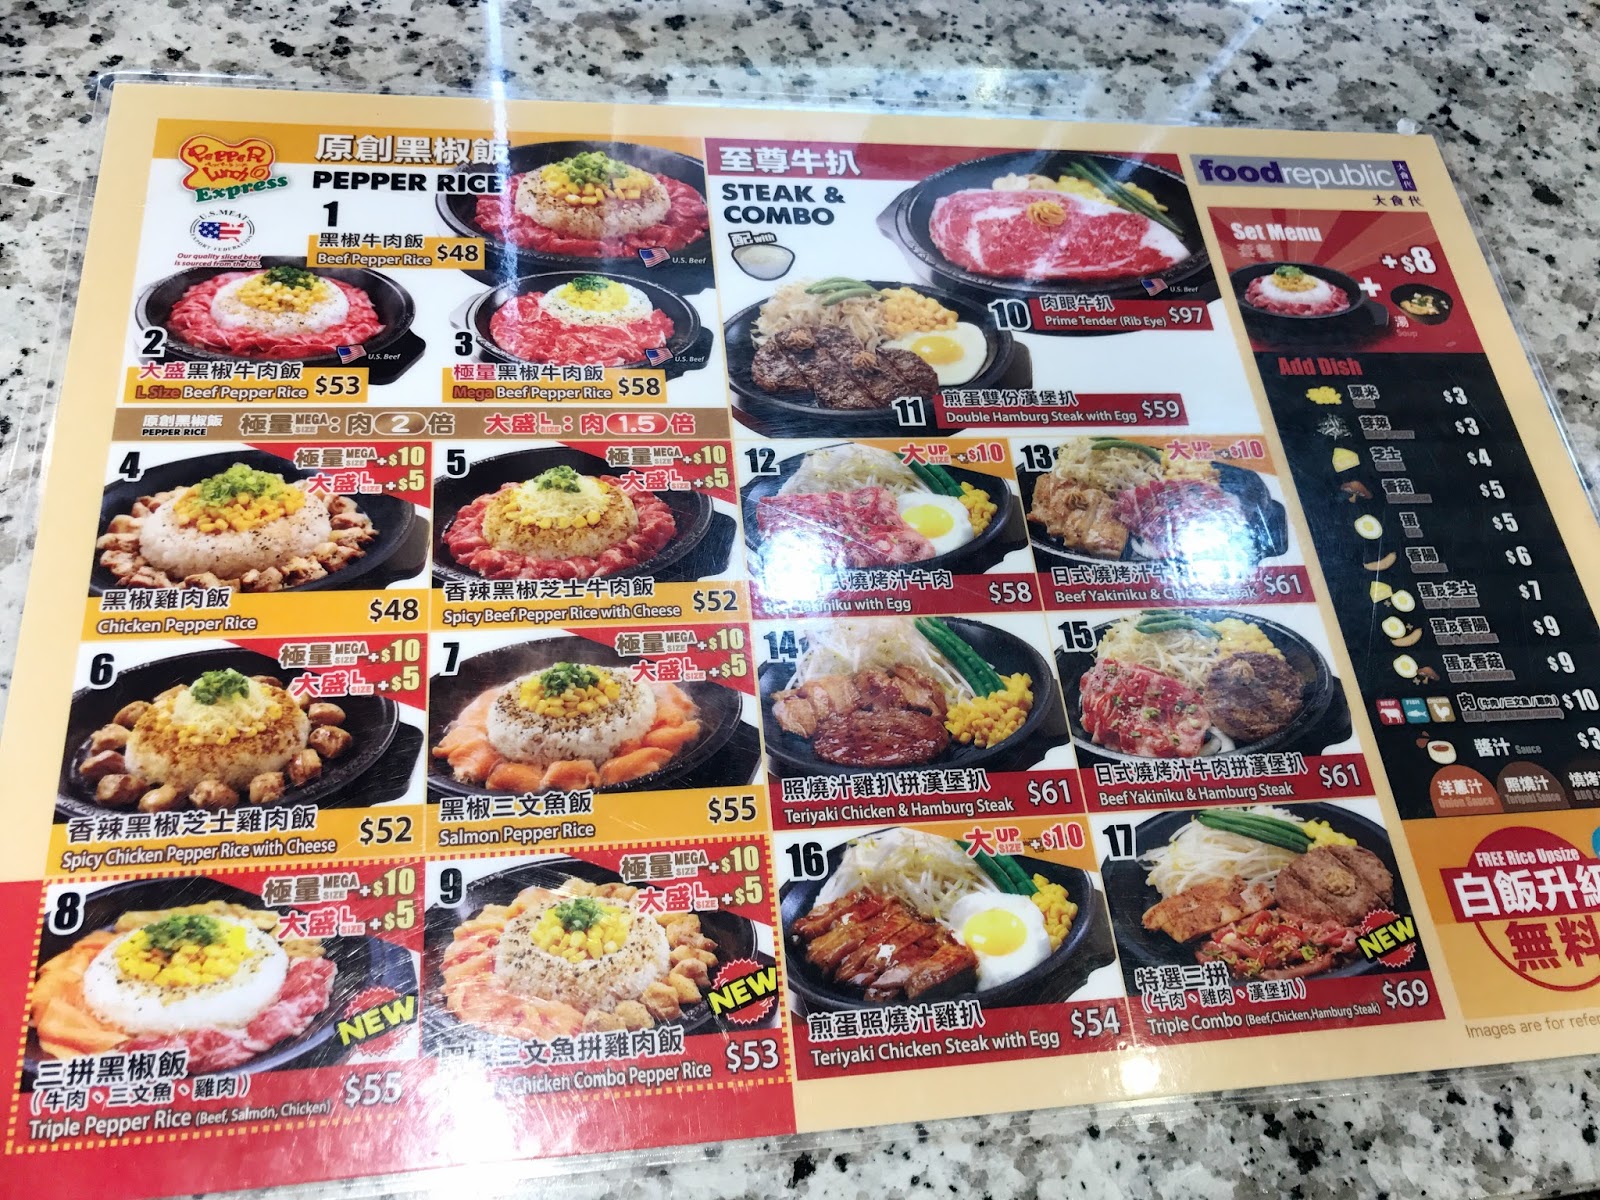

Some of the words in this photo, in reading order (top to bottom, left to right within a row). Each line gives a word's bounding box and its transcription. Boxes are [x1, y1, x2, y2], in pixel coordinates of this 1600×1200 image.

[719, 146, 862, 177] 至尊牛扒
[196, 176, 288, 202] Express
[312, 171, 427, 191] PEPPER
[437, 176, 504, 194] RICE
[721, 182, 816, 203] STEAK
[824, 186, 846, 204] &
[723, 205, 835, 225] COMBO
[318, 232, 425, 249] 黑椒牛肉飯
[1230, 222, 1265, 241] Set
[1267, 223, 1323, 242] Menu
[192, 253, 219, 261] quality
[316, 252, 351, 266] Beef
[351, 253, 400, 268] Pepper
[403, 255, 432, 266] Rice
[437, 244, 480, 262] $48
[688, 256, 706, 265] Beef
[1045, 315, 1077, 327] Prime
[1078, 316, 1119, 327] Tender
[1119, 315, 1140, 329] (Rib
[1140, 315, 1167, 329] Eye)
[1168, 307, 1204, 325] $97
[382, 353, 401, 361] Beef
[1277, 356, 1316, 376] Add
[1319, 357, 1364, 377] Dish
[139, 361, 303, 381] 大盛黑椒牛肉飯
[183, 386, 219, 399] Beef
[220, 386, 276, 402] Pepper
[277, 386, 308, 399] Rice
[315, 375, 361, 396] $53
[452, 386, 495, 401] Mega
[496, 386, 529, 399] Beef
[530, 387, 581, 403] Pepper
[582, 387, 612, 400] Rice
[617, 377, 661, 397] $58
[1443, 386, 1469, 406] $3
[946, 410, 991, 424] Double
[992, 411, 1049, 427] Hamburg
[1051, 410, 1084, 423] Steak
[1084, 409, 1112, 422] with
[1113, 411, 1138, 425] Egg
[1140, 400, 1180, 420] $59
[142, 428, 182, 437] PEPPER
[183, 428, 207, 437] RICE
[1454, 417, 1480, 436] $3
[1466, 448, 1493, 468] $4
[1479, 480, 1506, 500] $5
[1492, 512, 1519, 533] $5
[1505, 546, 1533, 566] $6
[444, 577, 654, 602] 香辣黑椒芝士牛肉飯
[988, 581, 1033, 604] $58
[1054, 590, 1087, 603] Beef
[1088, 588, 1147, 602] Yakiniku
[1149, 589, 1161, 601] &
[1263, 574, 1303, 596] $61
[1518, 580, 1542, 601] $7
[101, 587, 230, 611] 黑椒雞肉飯
[692, 589, 738, 613] $52
[855, 598, 884, 611] with
[886, 598, 912, 613] Egg
[369, 598, 419, 623] $48
[443, 609, 482, 625] Spicy
[484, 608, 517, 622] Beef
[517, 607, 568, 624] Pepper
[569, 606, 599, 620] Rice
[600, 605, 632, 619] with
[633, 603, 681, 618] Cheese
[96, 618, 162, 635] Chicken
[164, 617, 222, 635] Pepper
[223, 616, 257, 631] Rice
[1532, 615, 1561, 637] $9
[1547, 651, 1577, 674] $9
[1562, 688, 1600, 711] $10
[1319, 763, 1361, 789] $61
[1027, 779, 1073, 807] $61
[1099, 792, 1129, 807] Beef
[1129, 789, 1184, 805] Yakiniku
[1186, 789, 1197, 802] &
[1198, 785, 1258, 803] Hamburg
[1258, 782, 1295, 799] Steak
[439, 791, 593, 822] 黑椒三文魚飯
[708, 796, 756, 824] $55
[784, 807, 838, 826] Teriyaki
[840, 803, 896, 820] Chicken
[897, 803, 910, 817] &
[911, 799, 975, 819] Hamburg
[976, 797, 1015, 813] Steak
[68, 805, 317, 843] 香辣黑椒芝士雞肉飯
[359, 816, 412, 845] $52
[438, 827, 501, 847] Salmon
[502, 825, 561, 846] Pepper
[562, 823, 595, 840] Rice
[61, 851, 103, 871] Spicy
[105, 846, 165, 866] Chicken
[166, 844, 219, 865] Pepper
[220, 842, 250, 859] Rice
[252, 841, 284, 857] with
[286, 838, 336, 855] Cheese
[1474, 851, 1504, 868] FREE
[1506, 849, 1537, 866] Rice
[1536, 846, 1581, 865] Upsize
[1356, 916, 1417, 960] NEW
[707, 966, 777, 1016] NEW
[1382, 978, 1430, 1010] $69
[337, 995, 416, 1046] NEW
[1070, 1006, 1121, 1039] $54
[1146, 1016, 1190, 1037] Triple
[1191, 1011, 1243, 1031] Combo
[1353, 1002, 1382, 1018] Steak)
[1465, 1022, 1517, 1040] Images
[1520, 1020, 1543, 1032] are
[1545, 1016, 1565, 1030] for
[725, 1038, 780, 1072] $53
[811, 1045, 875, 1069] Teriyaki
[877, 1041, 942, 1060] Chicken
[944, 1036, 990, 1054] Steak
[991, 1032, 1028, 1049] with
[1029, 1030, 1061, 1050] Egg
[35, 1050, 188, 1088] 三拼黑椒飯
[511, 1072, 571, 1094] Chicken
[573, 1069, 626, 1089] Combo
[629, 1065, 681, 1088] Pepper
[682, 1062, 713, 1081] Rice
[344, 1071, 401, 1109] $55
[29, 1117, 82, 1142] Triple
[83, 1111, 152, 1138] Pepper
[154, 1108, 192, 1129] Rice
[194, 1106, 229, 1128] (Beef,
[230, 1104, 278, 1125] Salmon,
[280, 1098, 331, 1118] Chicken)
